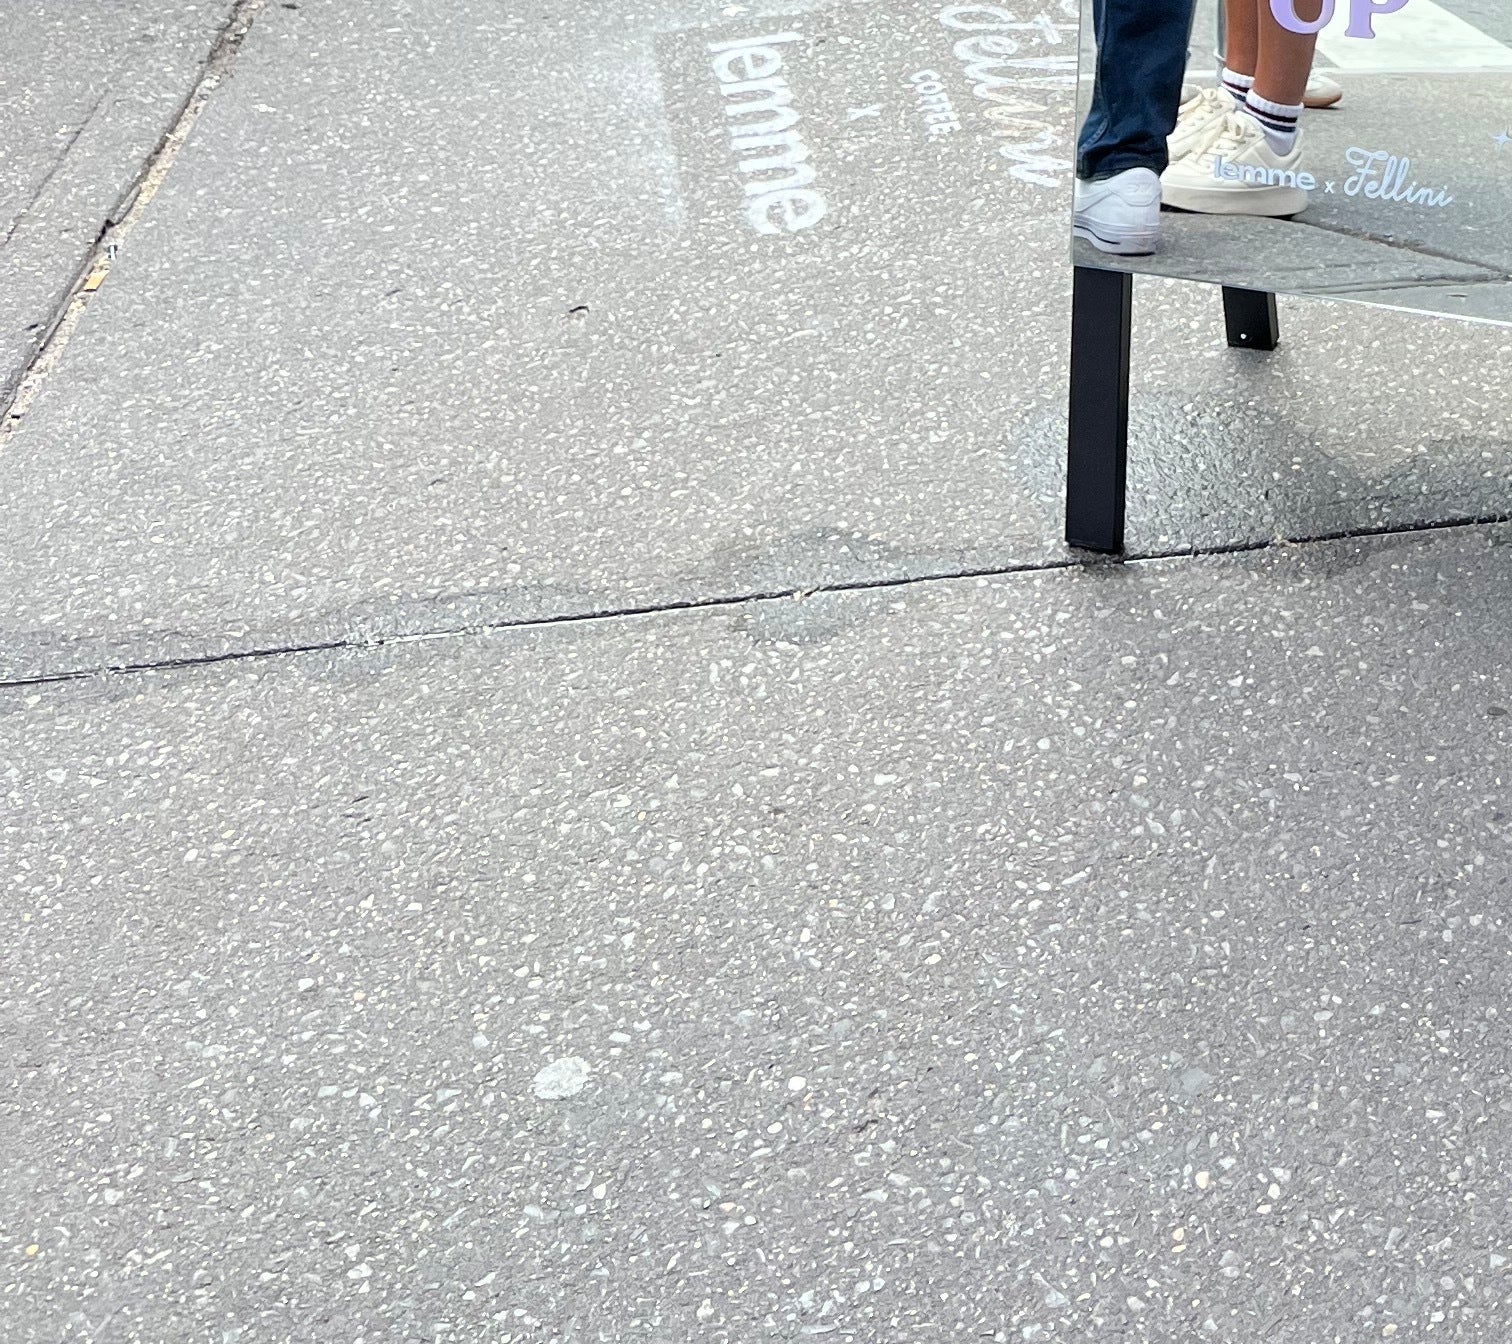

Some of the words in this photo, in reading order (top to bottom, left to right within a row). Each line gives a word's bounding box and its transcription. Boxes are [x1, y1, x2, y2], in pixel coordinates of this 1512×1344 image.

[708, 31, 829, 236] lemme
[909, 69, 962, 136] COFFEE
[1213, 154, 1316, 191] lemme
[1323, 179, 1335, 195] x
[1343, 146, 1454, 208] Fellini
